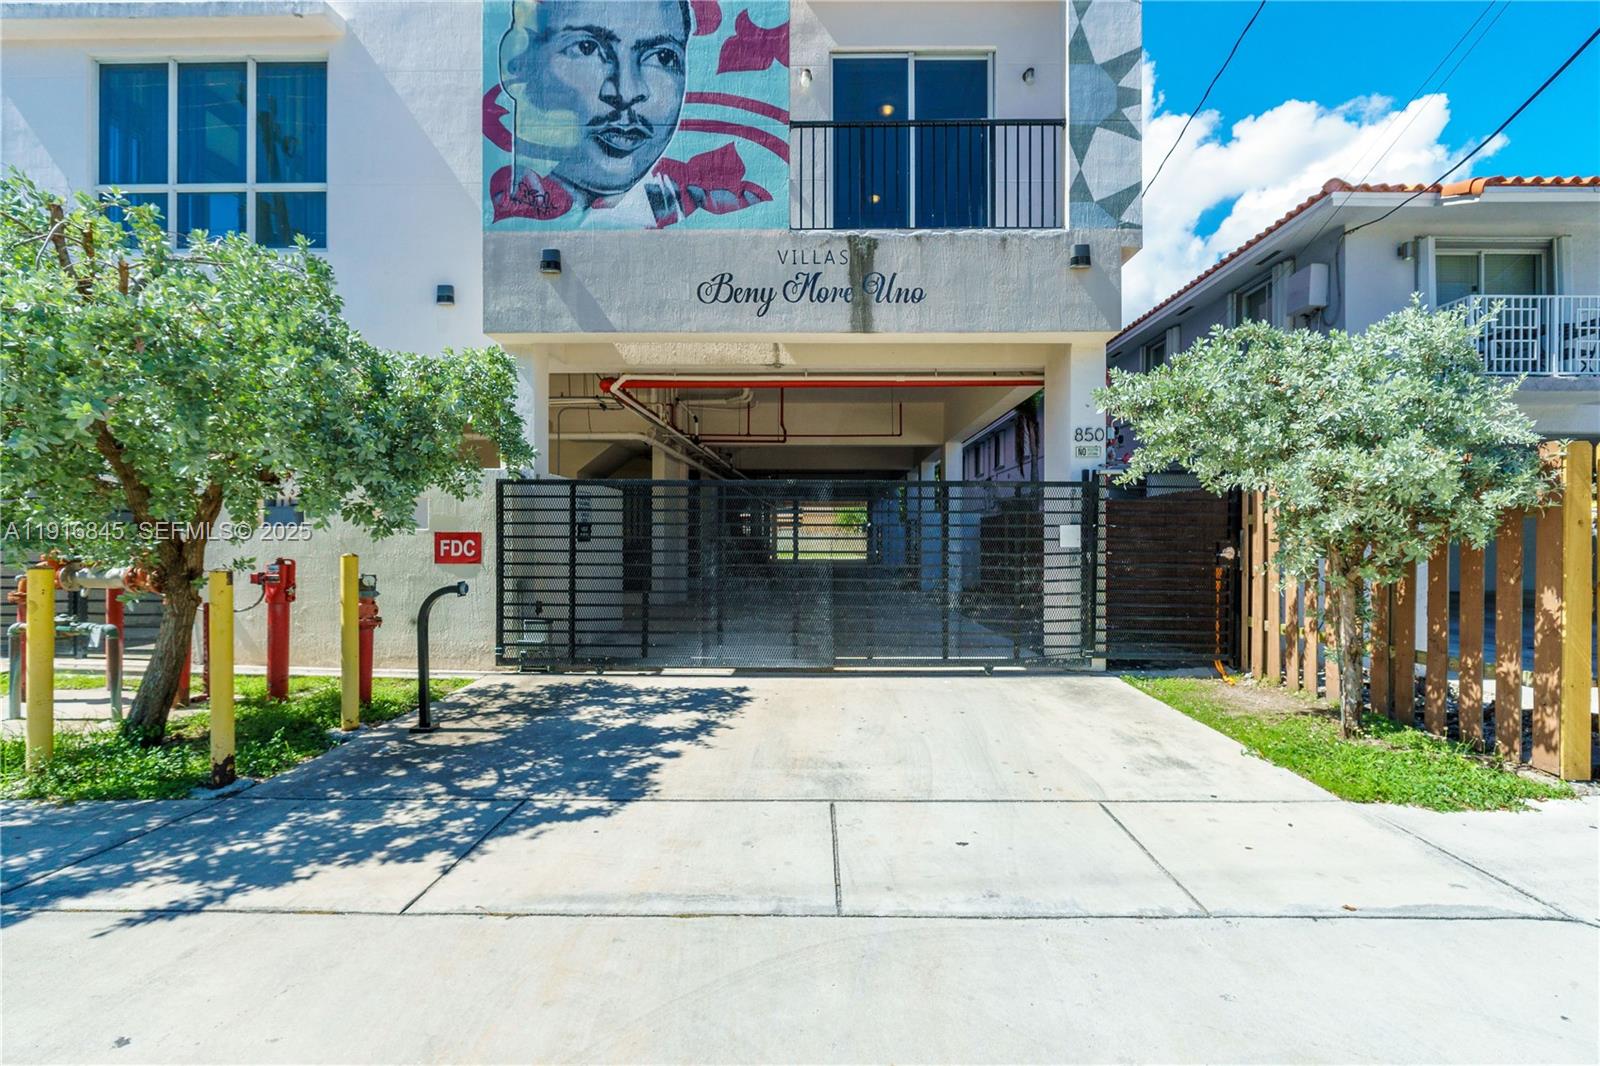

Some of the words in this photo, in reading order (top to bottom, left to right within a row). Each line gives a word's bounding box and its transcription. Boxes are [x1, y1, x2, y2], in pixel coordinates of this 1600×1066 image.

[777, 249, 849, 265] VILLAS
[697, 272, 777, 317] Beny
[862, 271, 927, 304] Uno
[1074, 427, 1105, 442] 850
[439, 539, 476, 557] FDC
